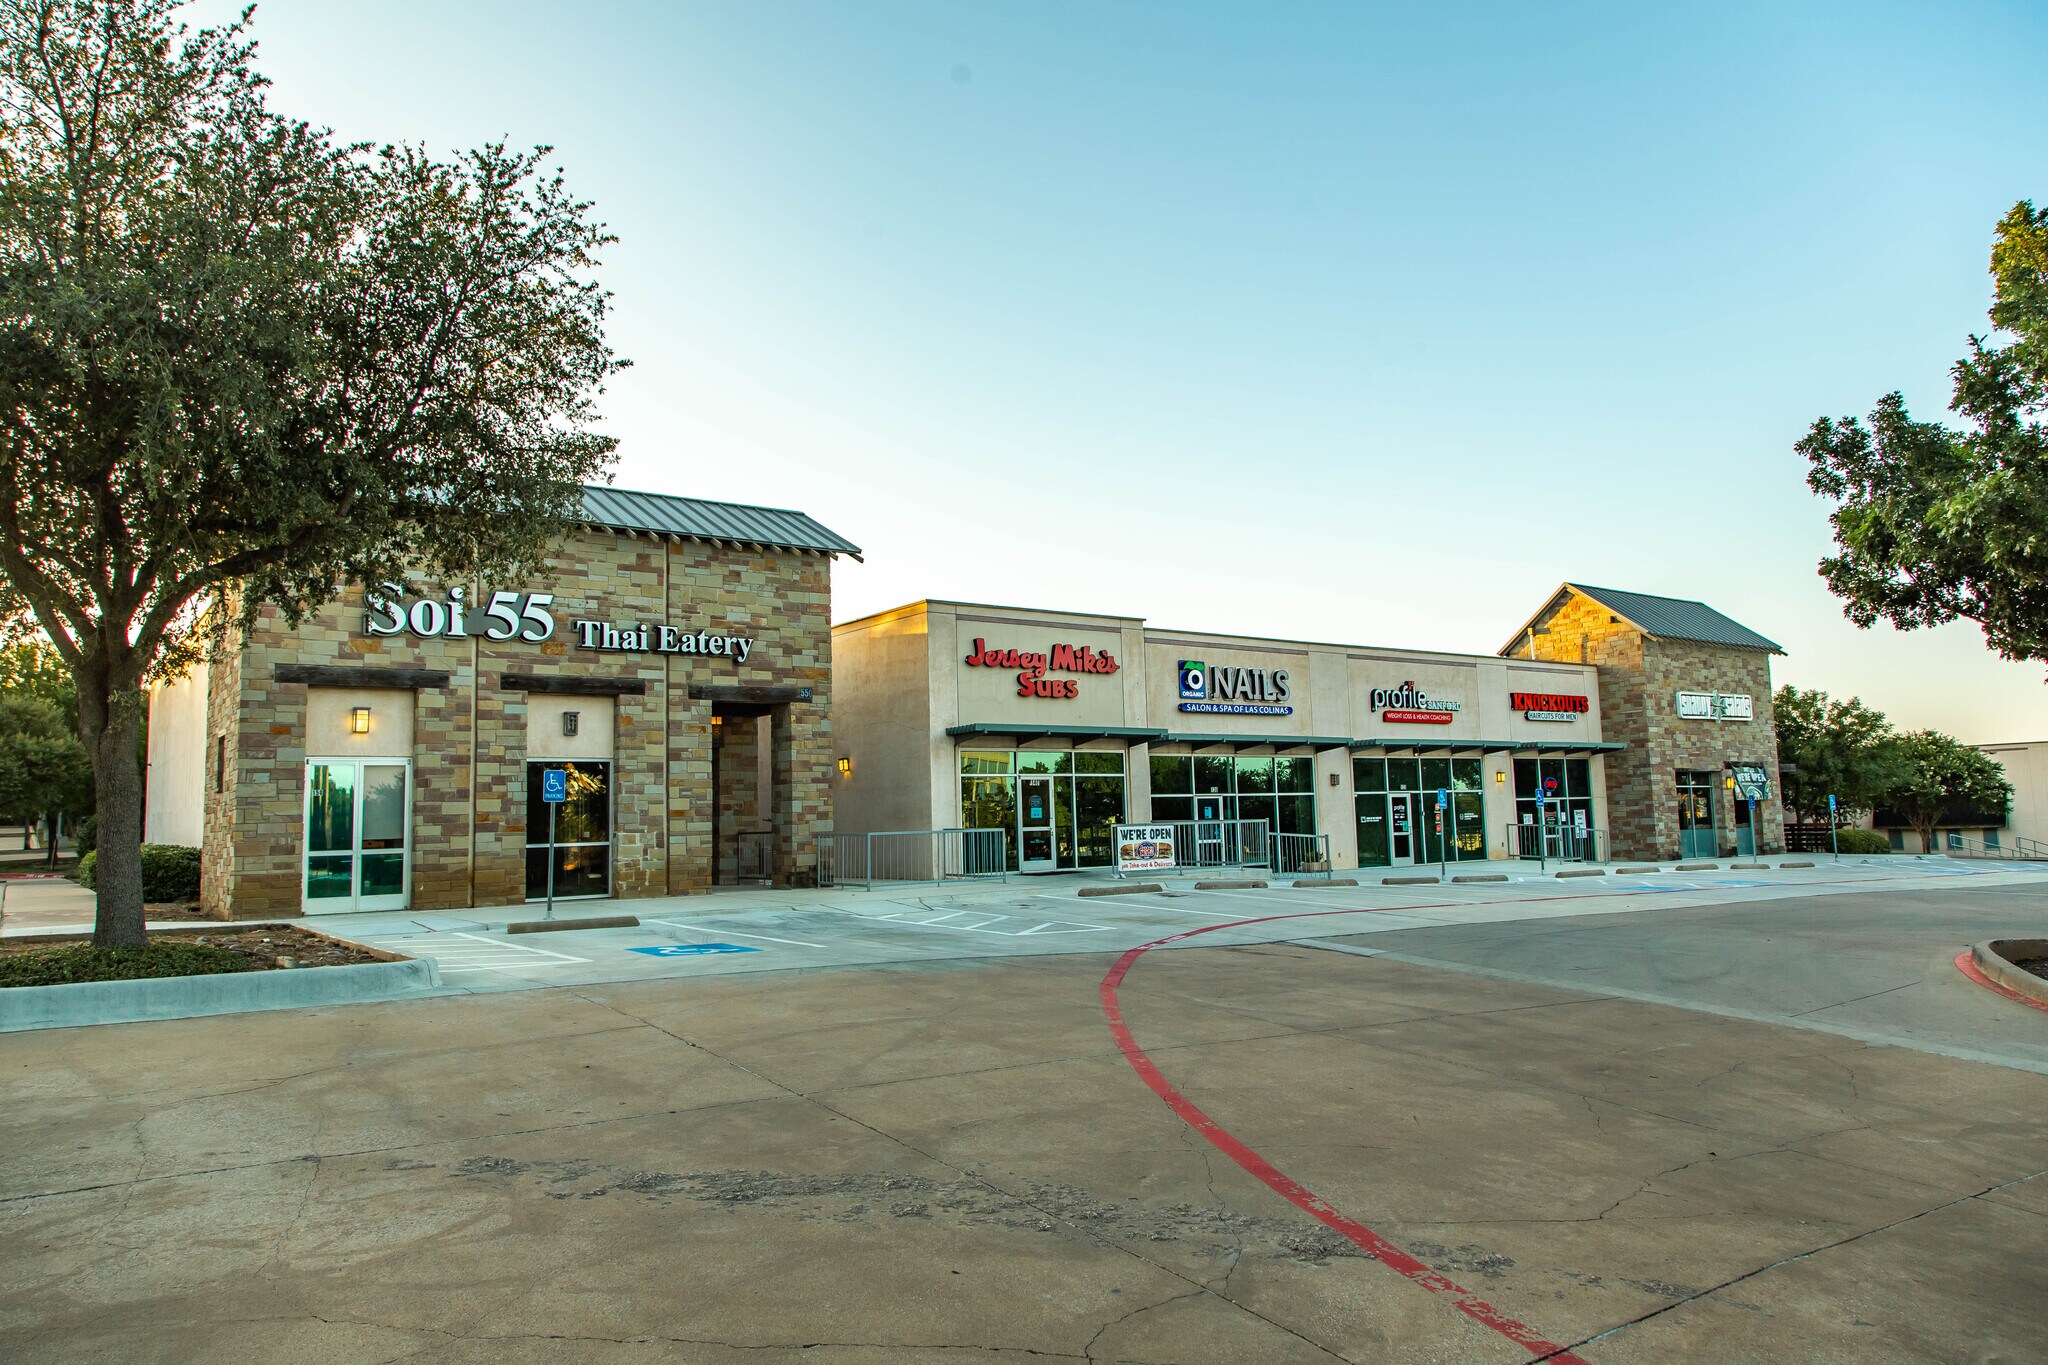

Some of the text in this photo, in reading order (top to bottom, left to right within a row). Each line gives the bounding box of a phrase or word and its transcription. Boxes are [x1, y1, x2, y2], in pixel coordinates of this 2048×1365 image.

[364, 582, 554, 643] Soi 55
[574, 620, 753, 663] Thai Eatery
[966, 638, 1120, 677] Jersey Mike's
[800, 688, 813, 698] 550
[1209, 665, 1290, 703] NAILS
[1372, 684, 1427, 712] profile
[1186, 703, 1289, 714] SALON & SPA OF LAS COLINAS
[1512, 693, 1589, 713] KNOCKOUTS
[1120, 828, 1172, 841] WE'RE OPEN
